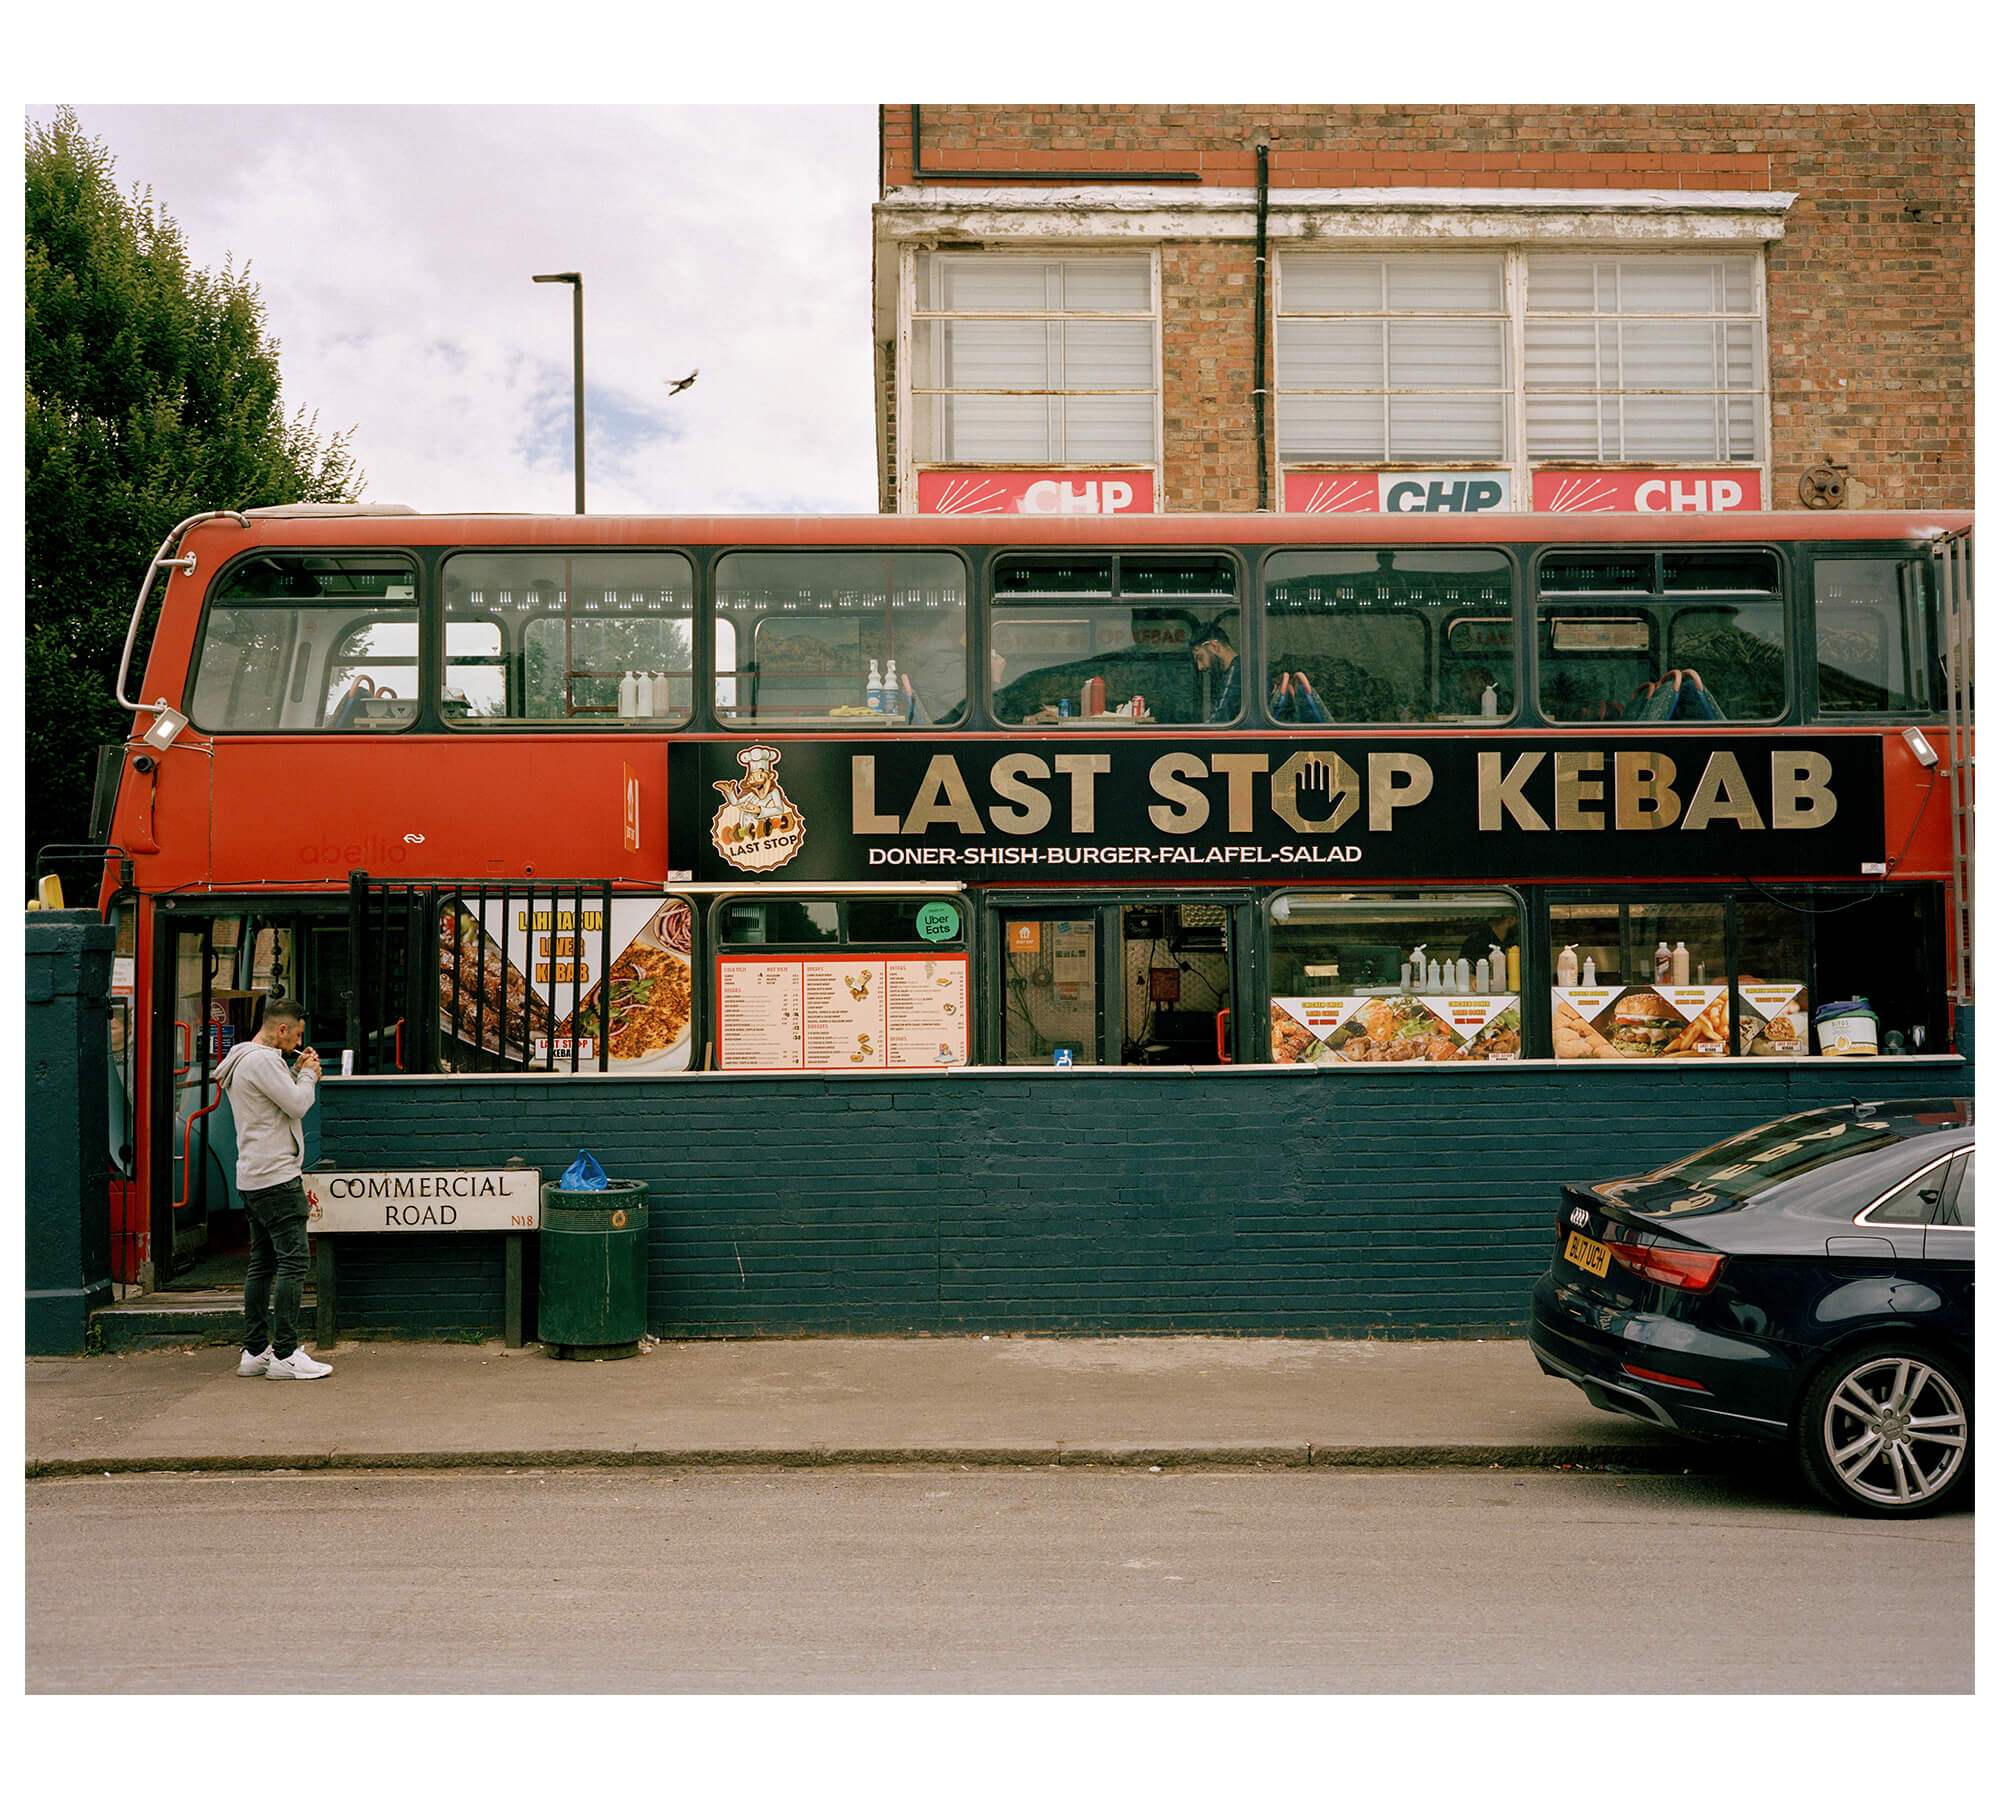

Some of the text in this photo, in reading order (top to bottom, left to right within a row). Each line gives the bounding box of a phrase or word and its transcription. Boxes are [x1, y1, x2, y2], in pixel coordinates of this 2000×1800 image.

[1024, 480, 1133, 513] CHP
[1387, 480, 1502, 512] CHP
[1634, 480, 1743, 512] CHP
[852, 750, 1838, 836] LAST STOP KEBAB
[299, 832, 407, 865] abellio
[730, 834, 797, 857] LAST STOP
[869, 846, 1362, 865] DONER-SHISH-BURGER-FALAFEL-SALAD
[925, 915, 949, 925] Uber
[926, 925, 951, 935] Eats
[553, 1049, 571, 1058] KEBA
[330, 1177, 513, 1199] COMMERCIAL
[385, 1205, 457, 1226] ROAD
[511, 1215, 533, 1226] N18
[1569, 1236, 1589, 1263] BL17
